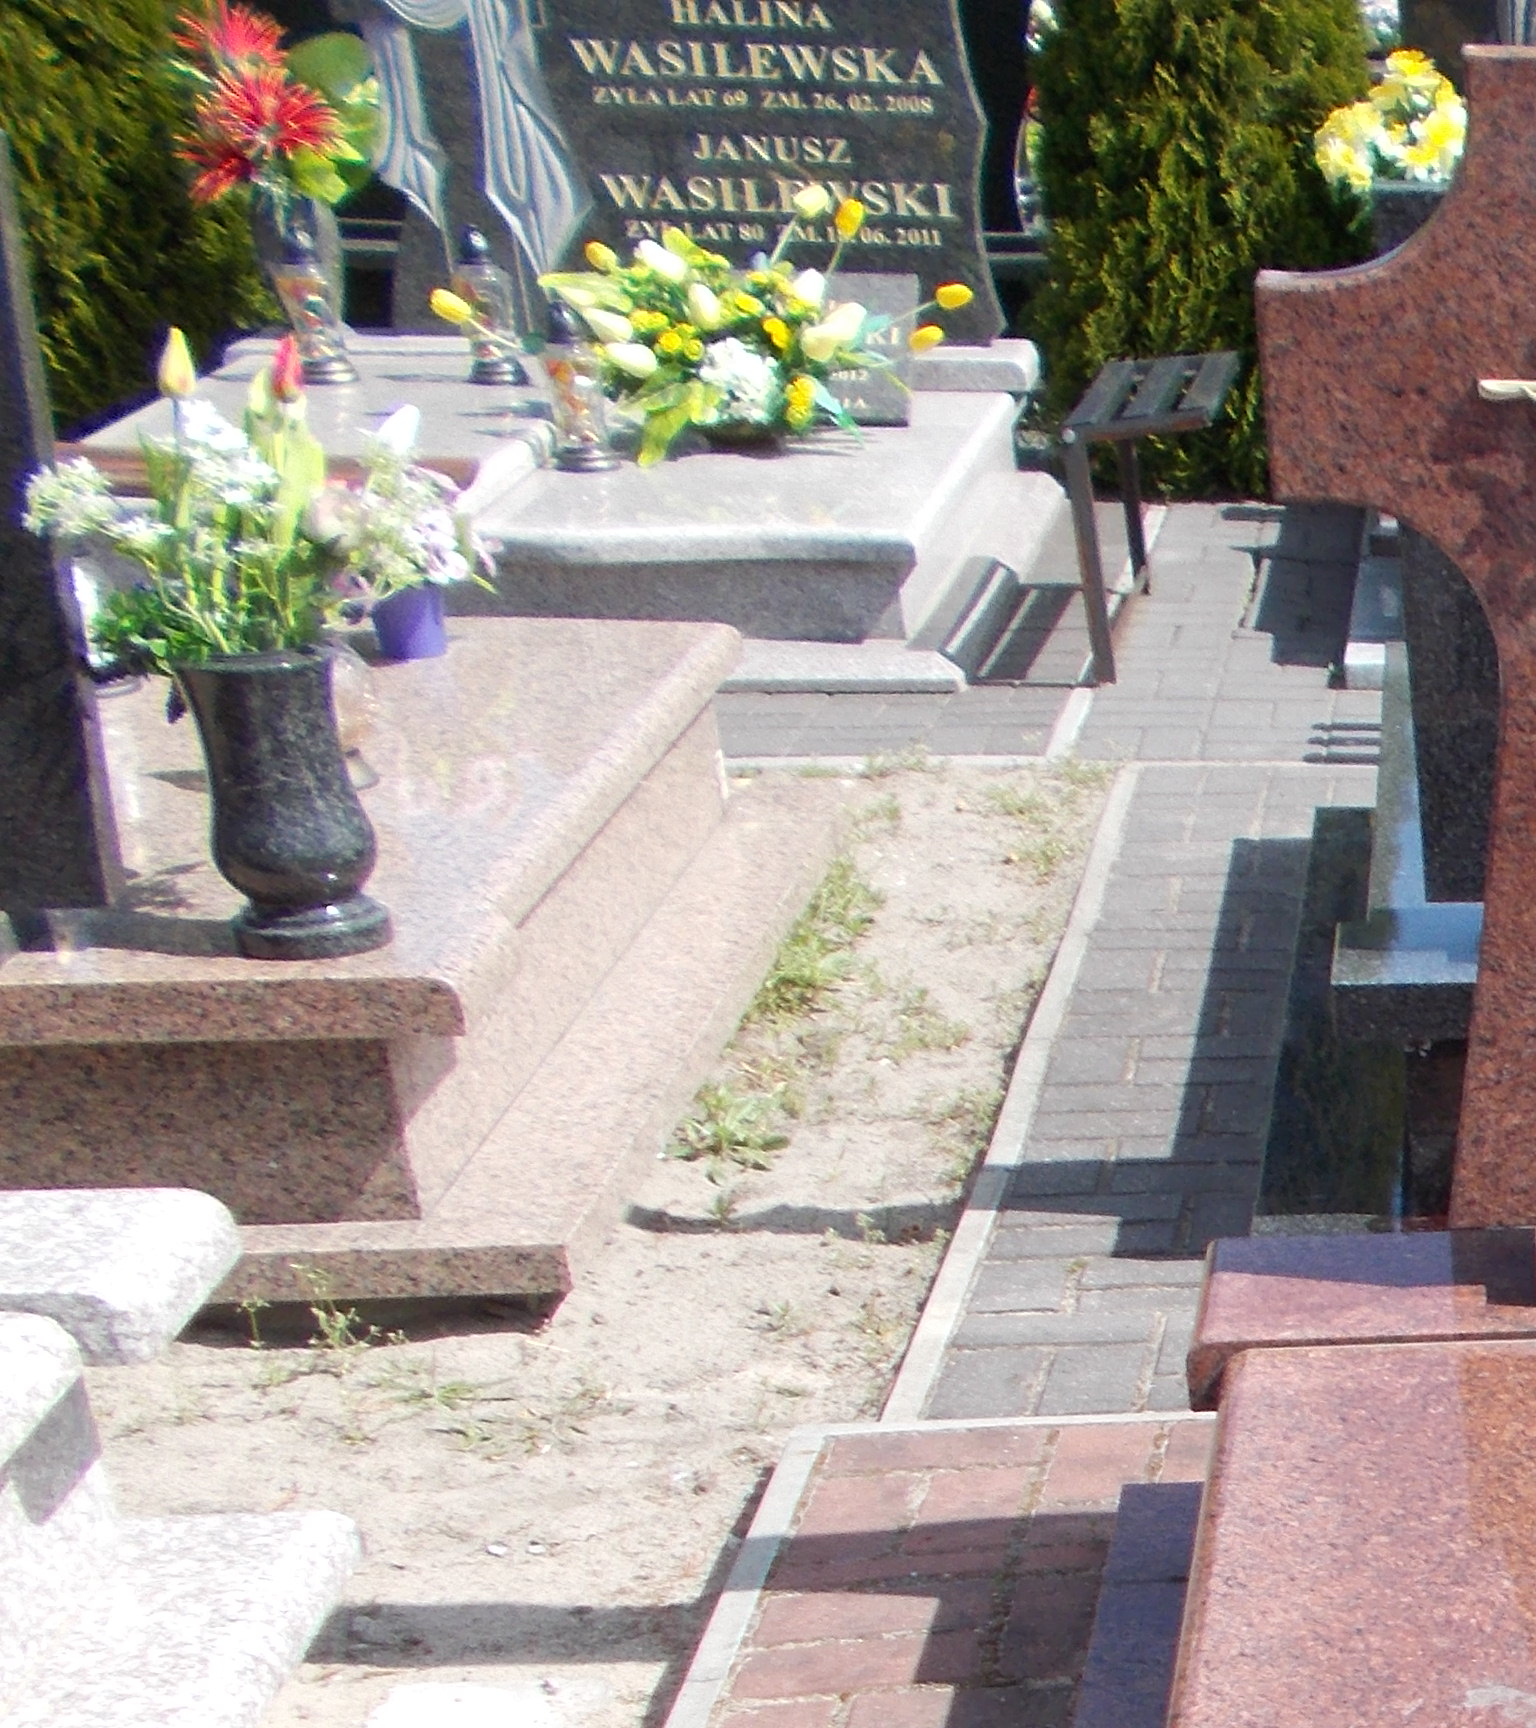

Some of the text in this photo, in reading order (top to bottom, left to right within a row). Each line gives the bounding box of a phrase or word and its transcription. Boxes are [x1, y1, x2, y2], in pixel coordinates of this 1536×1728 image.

[670, 0, 833, 30] HALINA
[570, 38, 945, 86] WASILEWSKA
[666, 87, 718, 107] LAT
[692, 132, 852, 163] JANUSZ
